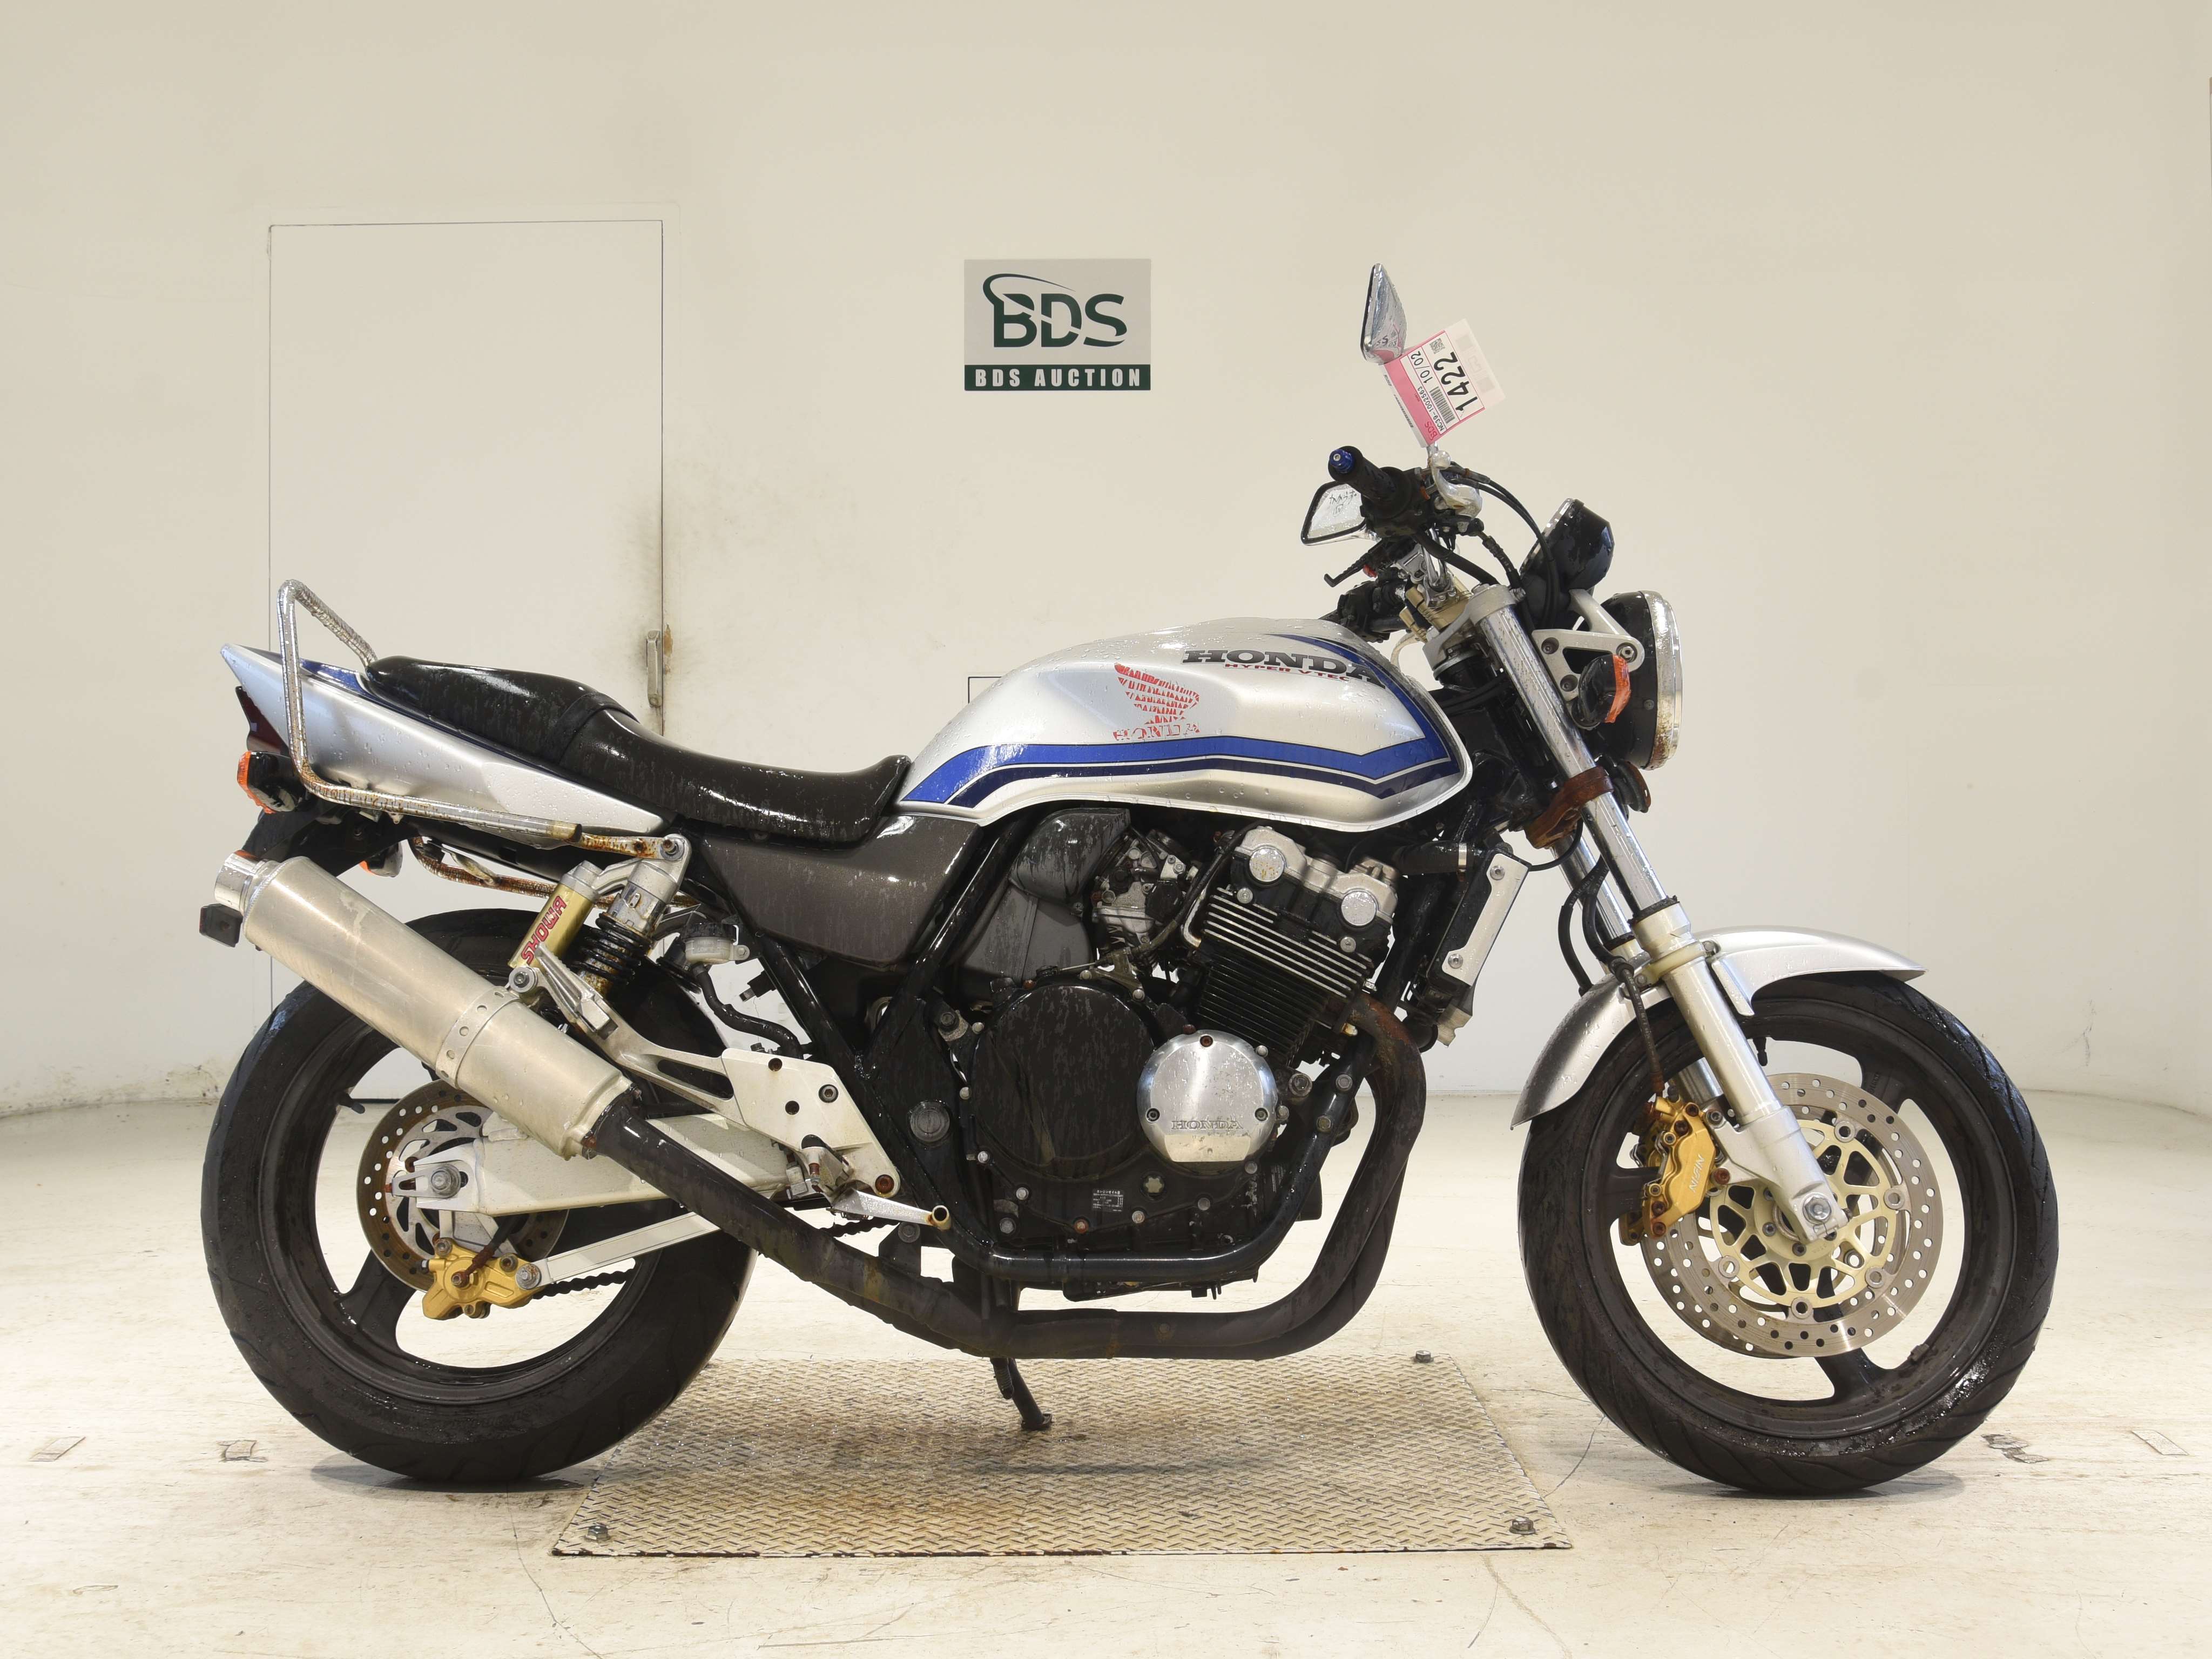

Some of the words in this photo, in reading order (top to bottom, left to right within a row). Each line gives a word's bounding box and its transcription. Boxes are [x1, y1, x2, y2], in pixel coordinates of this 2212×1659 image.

[983, 273, 1128, 348] BDS
[975, 368, 1021, 387] BDS
[1034, 368, 1141, 387] AUCTION
[1411, 350, 1433, 383] 10/02
[1433, 352, 1478, 411] 1422
[1425, 421, 1438, 441] BDS
[1183, 650, 1386, 690] HONDA
[1225, 663, 1291, 672] HYPER
[1298, 669, 1351, 682] VTEC
[521, 895, 567, 966] SHOWA
[1171, 1120, 1244, 1130] HONDA
